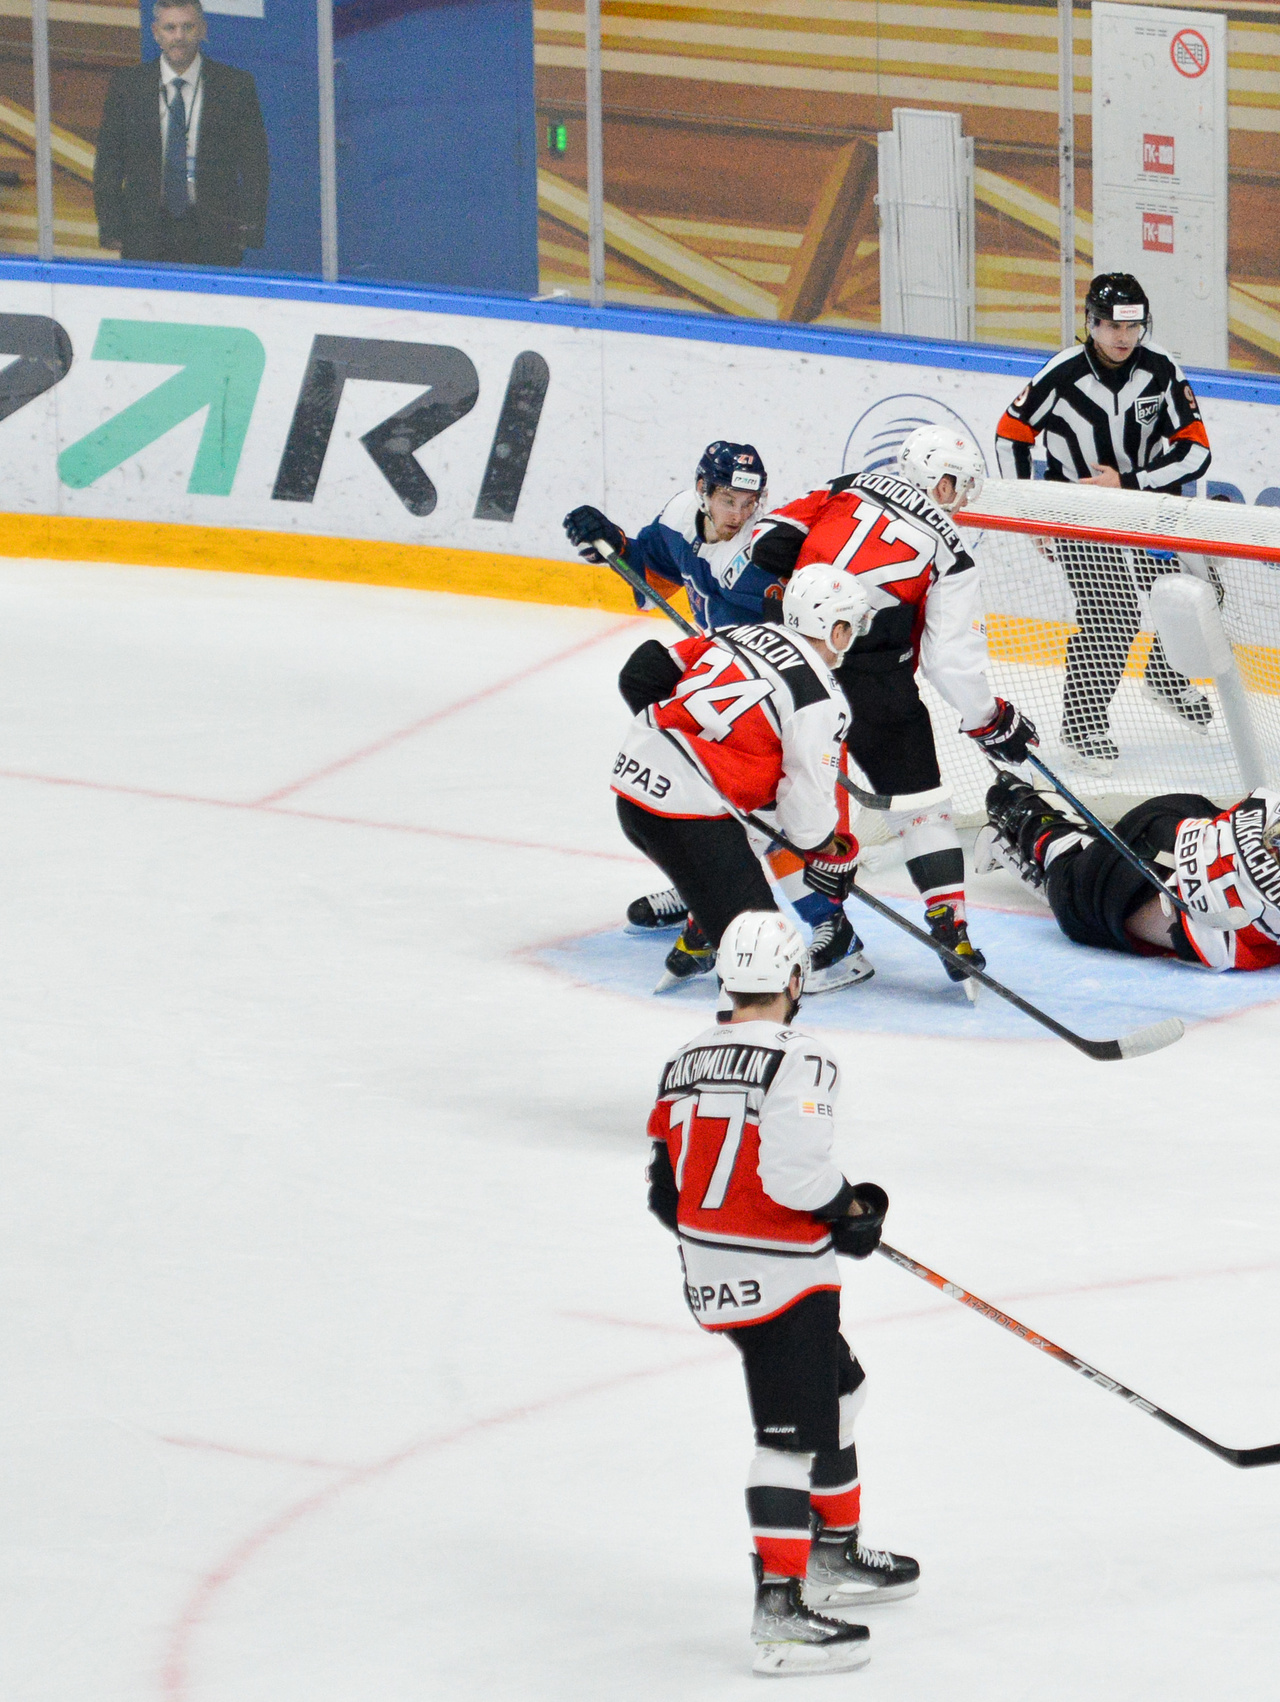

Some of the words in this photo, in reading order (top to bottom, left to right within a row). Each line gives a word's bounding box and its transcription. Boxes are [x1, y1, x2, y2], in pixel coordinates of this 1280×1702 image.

[850, 473, 965, 553] RODIONYCHEV
[831, 500, 938, 607] 12
[788, 613, 799, 628] 24
[727, 625, 804, 671] MASLOV
[659, 646, 776, 743] 24
[612, 751, 671, 800] ВРАЗ
[1180, 829, 1209, 913] ЕВРАЗ
[737, 953, 753, 968] 77
[665, 1048, 772, 1091] RAKHIMULLIN
[804, 1055, 838, 1092] 77
[669, 1093, 748, 1210] 77
[1072, 1358, 1158, 1414] TRUE
